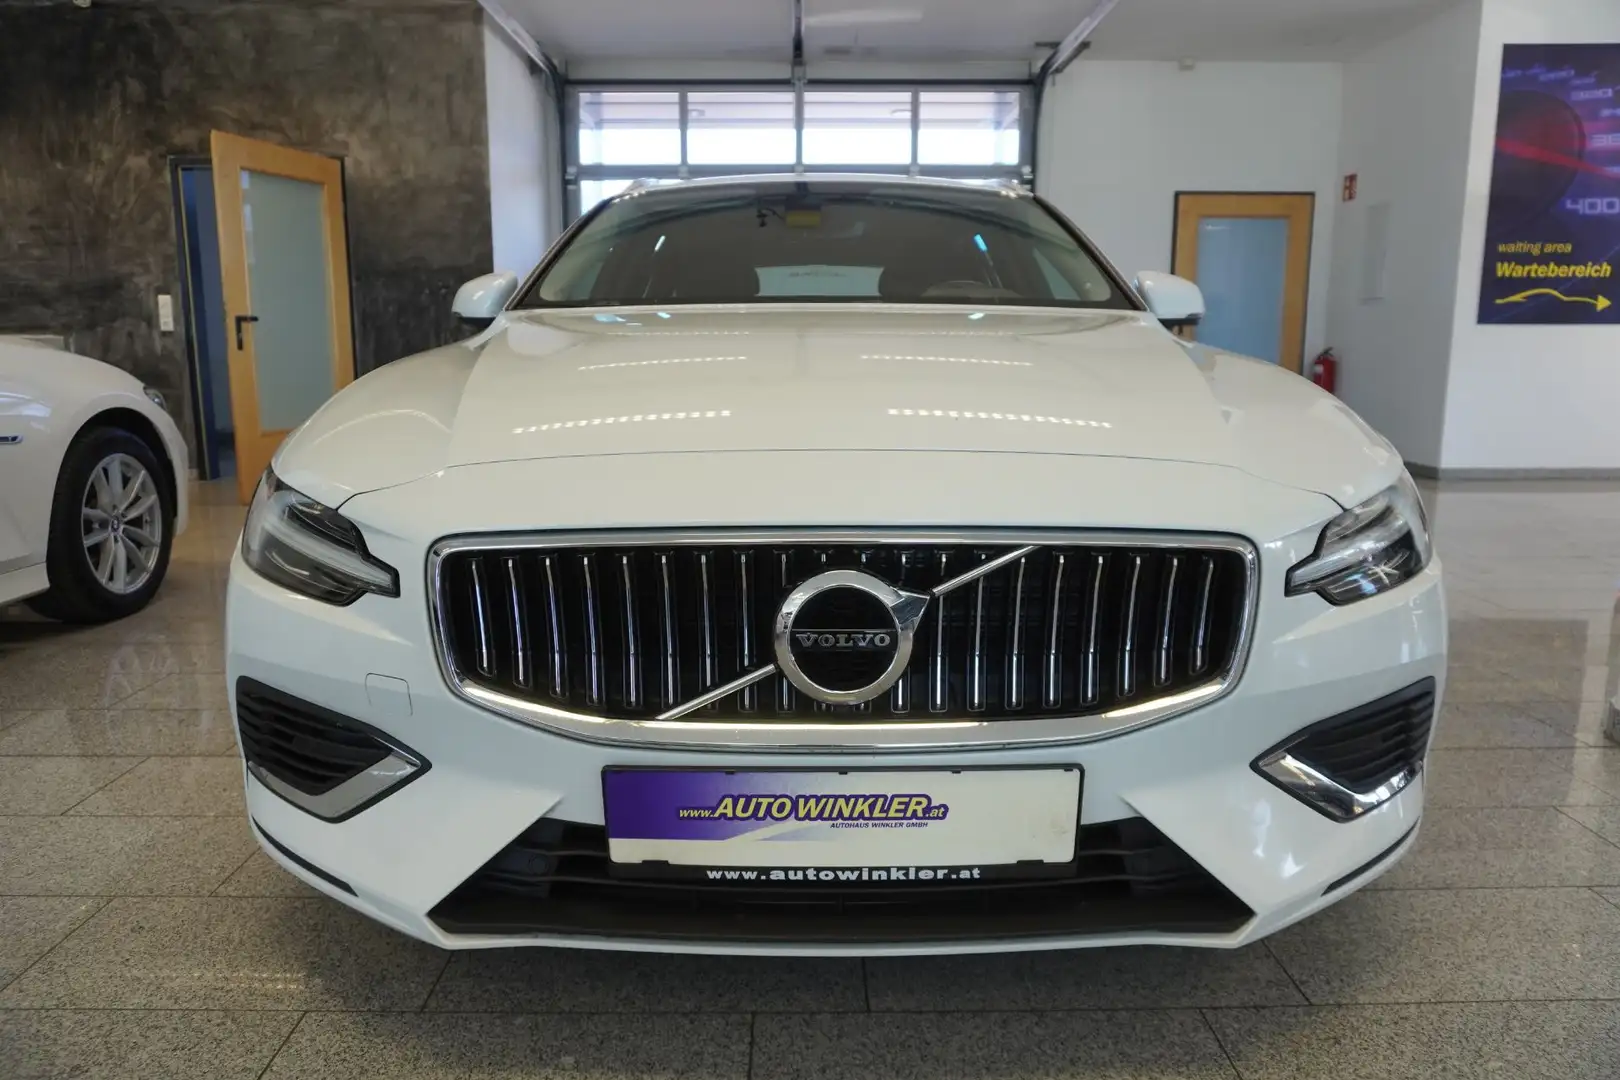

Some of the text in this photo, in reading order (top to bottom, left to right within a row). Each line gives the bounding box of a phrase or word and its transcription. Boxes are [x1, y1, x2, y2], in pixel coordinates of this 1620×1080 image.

[1498, 241, 1573, 256] waiting area
[1496, 261, 1612, 278] Wartebereich
[796, 633, 891, 647] VOLVO
[706, 867, 981, 881] www.autowinkler.at
